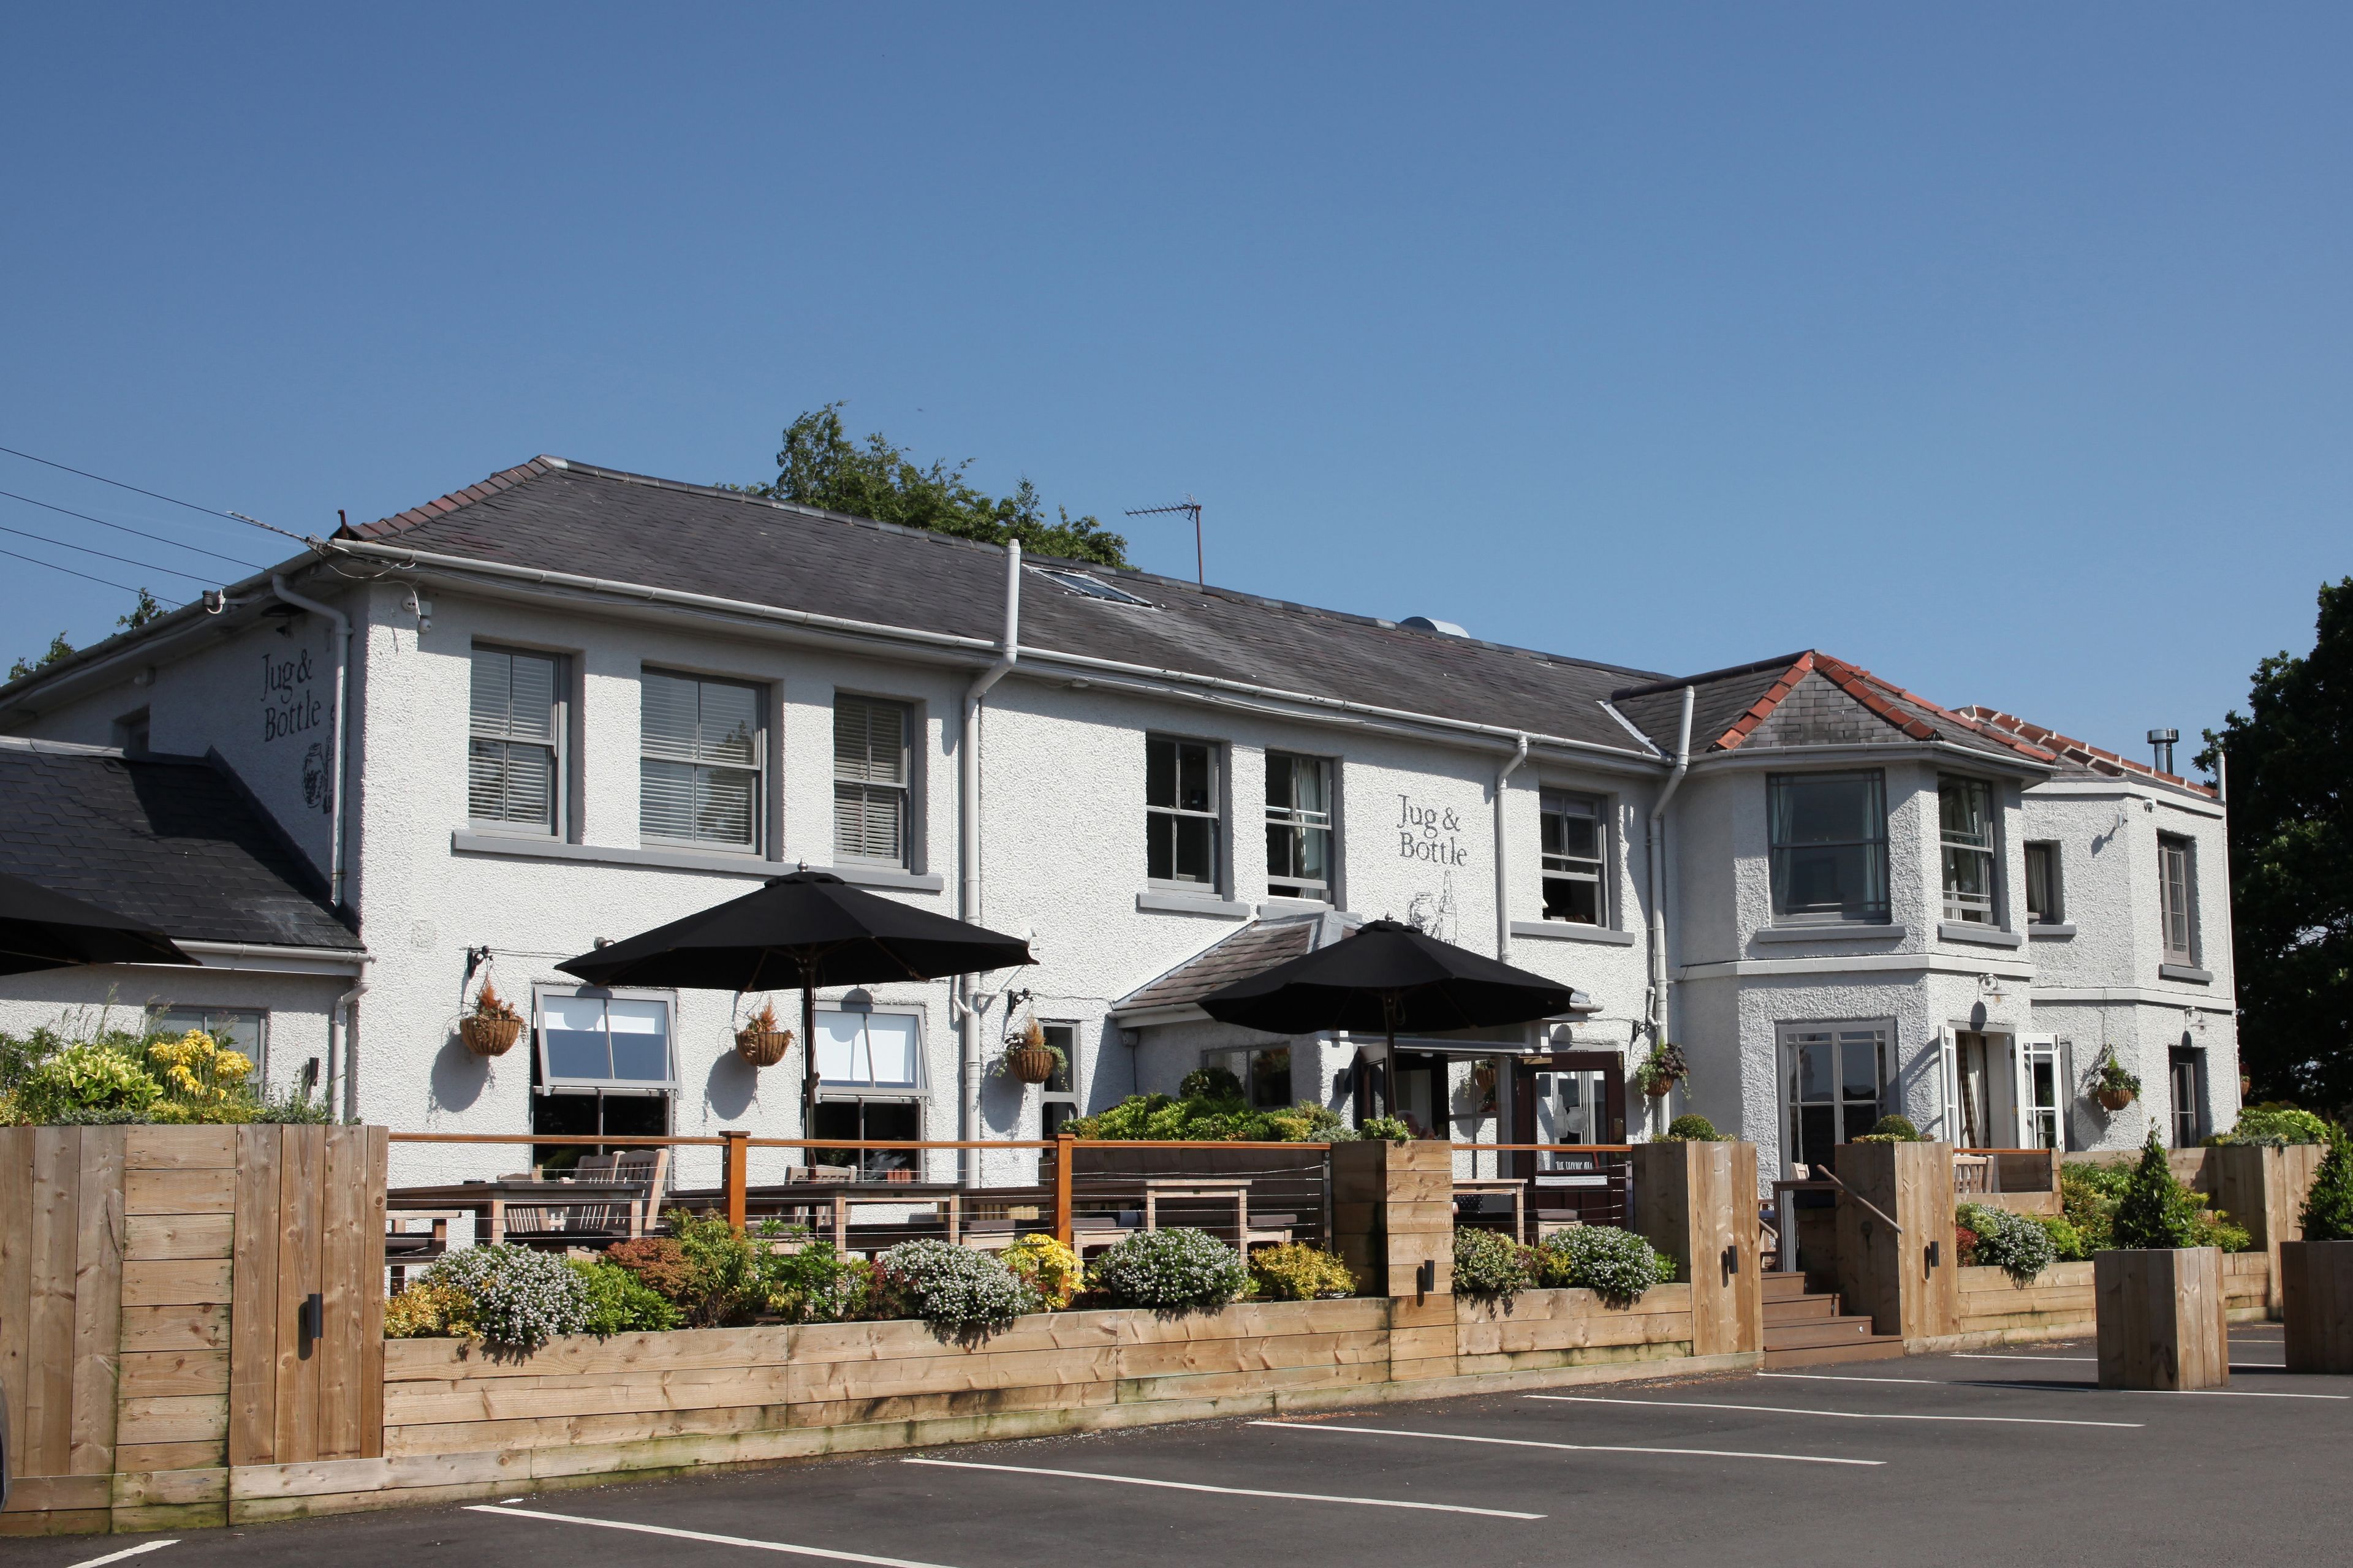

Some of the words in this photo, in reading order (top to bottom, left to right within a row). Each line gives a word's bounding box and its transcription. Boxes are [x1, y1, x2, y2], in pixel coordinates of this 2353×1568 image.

[261, 653, 295, 704] Jug
[297, 648, 313, 684] &
[265, 689, 322, 742] Bottle
[1397, 794, 1438, 839] Jug
[1442, 806, 1461, 831] &
[1400, 831, 1468, 866] Bottle
